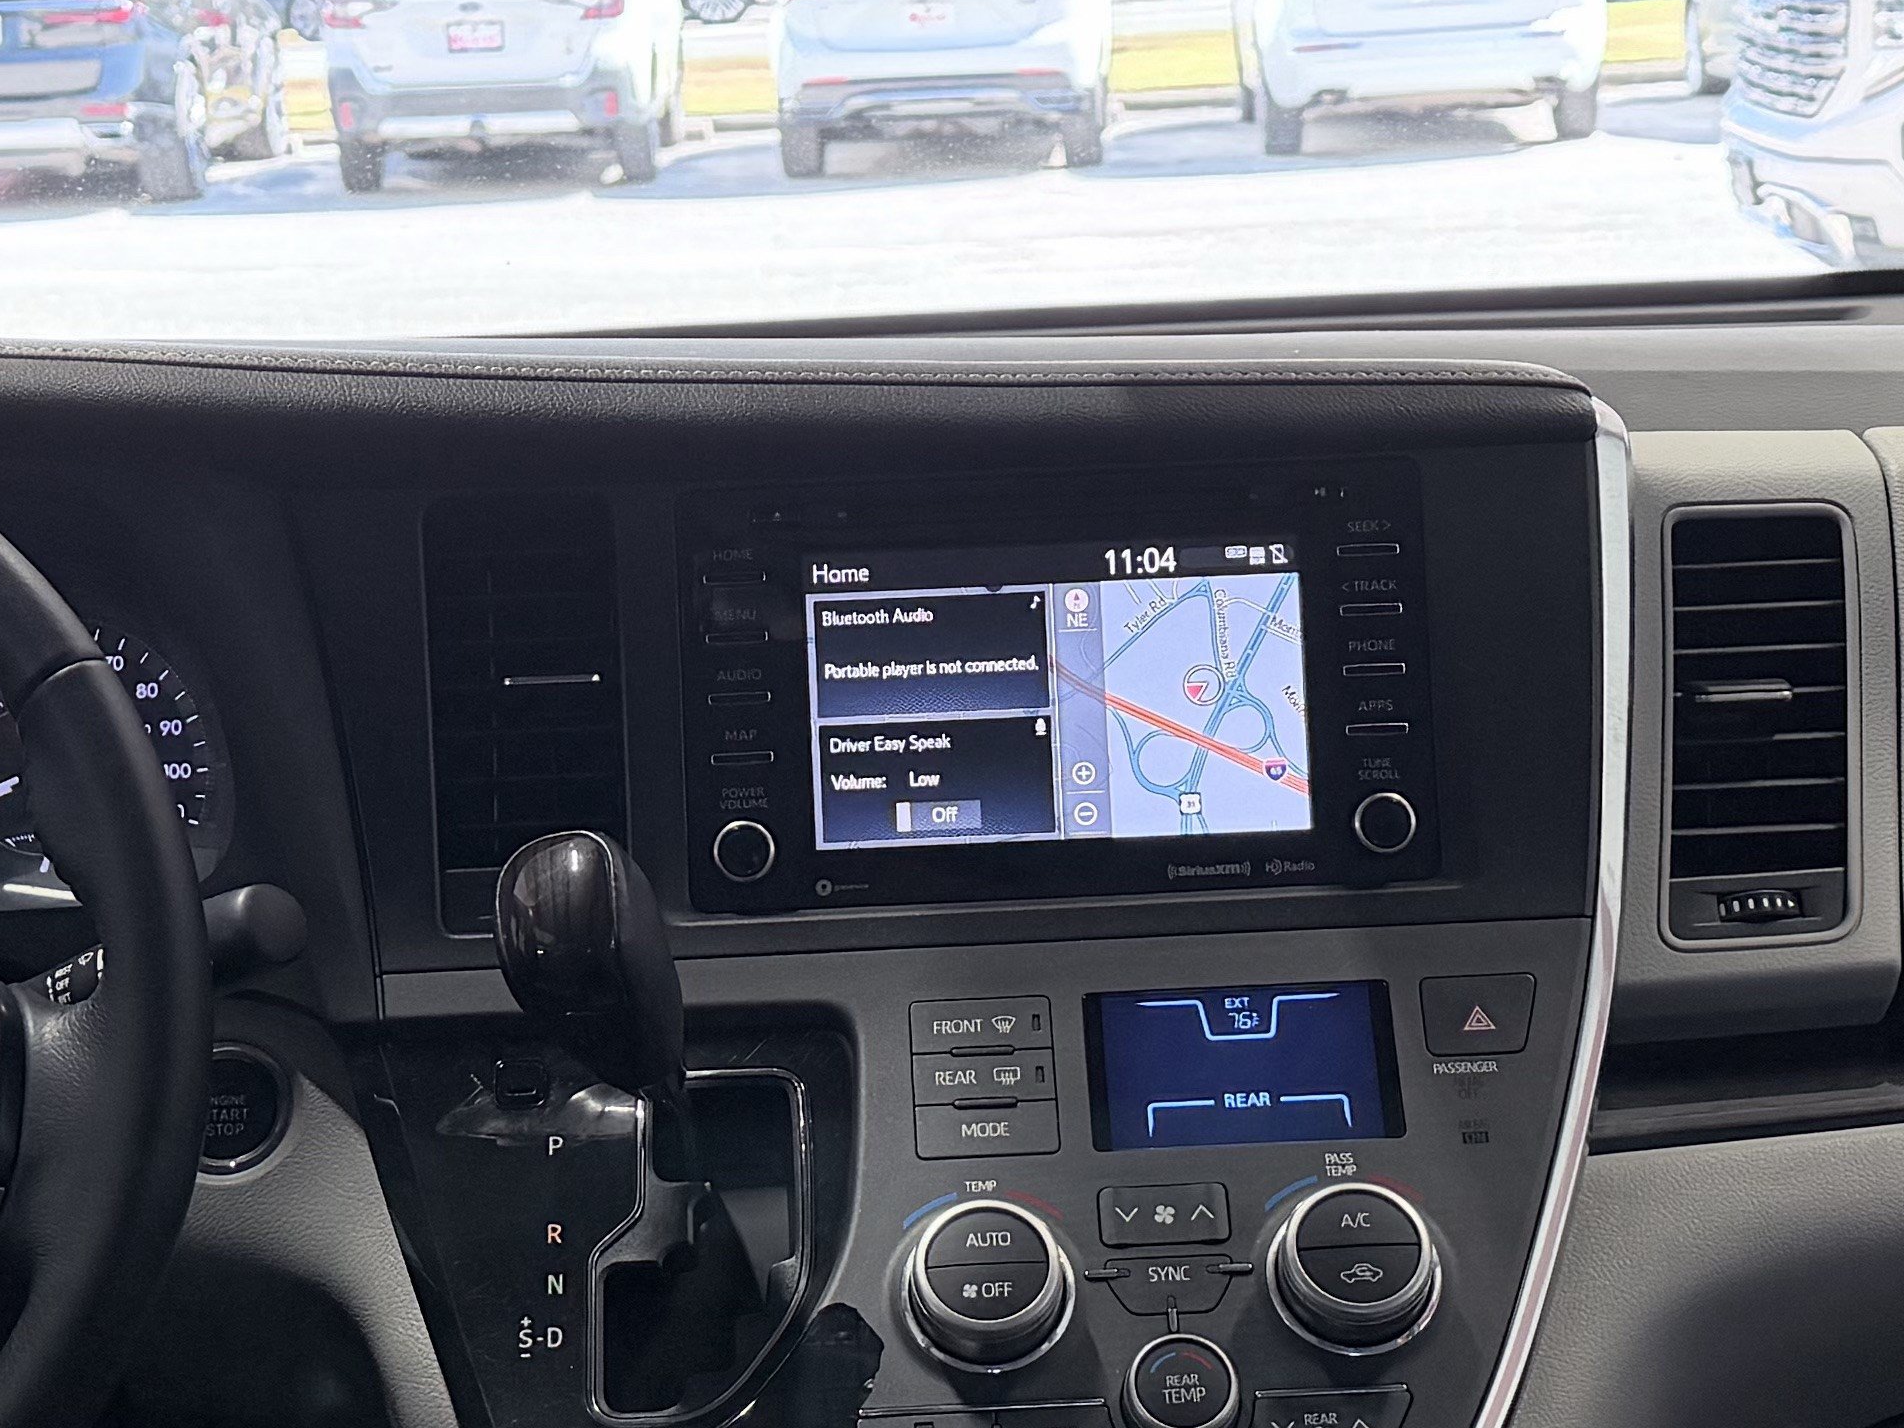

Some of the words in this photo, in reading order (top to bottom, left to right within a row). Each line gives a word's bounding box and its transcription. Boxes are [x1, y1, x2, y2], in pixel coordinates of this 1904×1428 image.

[712, 548, 754, 561] HOME
[1104, 546, 1177, 576] 11:04
[812, 563, 870, 584] Home
[1353, 578, 1398, 591] TRACK
[821, 609, 890, 627] Bluetooth
[892, 606, 934, 623] Audio
[1066, 612, 1089, 628] NE
[1123, 610, 1151, 634] Tyler
[1148, 597, 1167, 615] Rd
[1348, 638, 1396, 652] PHONE
[824, 661, 881, 680] Portable
[882, 660, 924, 679] player
[926, 660, 937, 675] is
[939, 659, 963, 675] not
[964, 654, 1039, 673] connected.
[716, 669, 762, 682] AUDIO
[135, 682, 159, 699] 80
[1358, 699, 1394, 712] APPS
[159, 719, 182, 736] 90
[724, 729, 757, 742] MAP
[829, 737, 872, 754] Driver
[874, 735, 906, 754] Easy
[909, 733, 952, 753] Speak
[163, 763, 192, 779] 100
[830, 773, 887, 791] Volume:
[909, 770, 940, 788] Low
[721, 786, 765, 799] POWER
[719, 796, 768, 810] VOLUME
[931, 805, 958, 823] Off
[1224, 997, 1250, 1010] EXT
[932, 1018, 983, 1035] FRONT
[1432, 1060, 1499, 1074] PASSENGER
[934, 1069, 977, 1086] REAR
[210, 1094, 245, 1106] NGINE
[1223, 1091, 1271, 1108] REAR
[209, 1108, 248, 1121] TART
[205, 1123, 244, 1136] STOP
[961, 1121, 1010, 1138] MODE
[548, 1135, 564, 1156] P
[1324, 1152, 1354, 1165] PASS
[1325, 1164, 1357, 1178] TEMP
[964, 1179, 997, 1193] TEMP
[1341, 1212, 1371, 1228] A/C
[547, 1223, 563, 1244] R
[965, 1231, 1011, 1248] AUTO
[1148, 1265, 1191, 1283] SYNC
[547, 1273, 564, 1295] N
[981, 1281, 1013, 1299] OFF
[1165, 1372, 1200, 1387] REAR
[1161, 1386, 1206, 1404] TEMP
[1304, 1411, 1338, 1426] REAR
